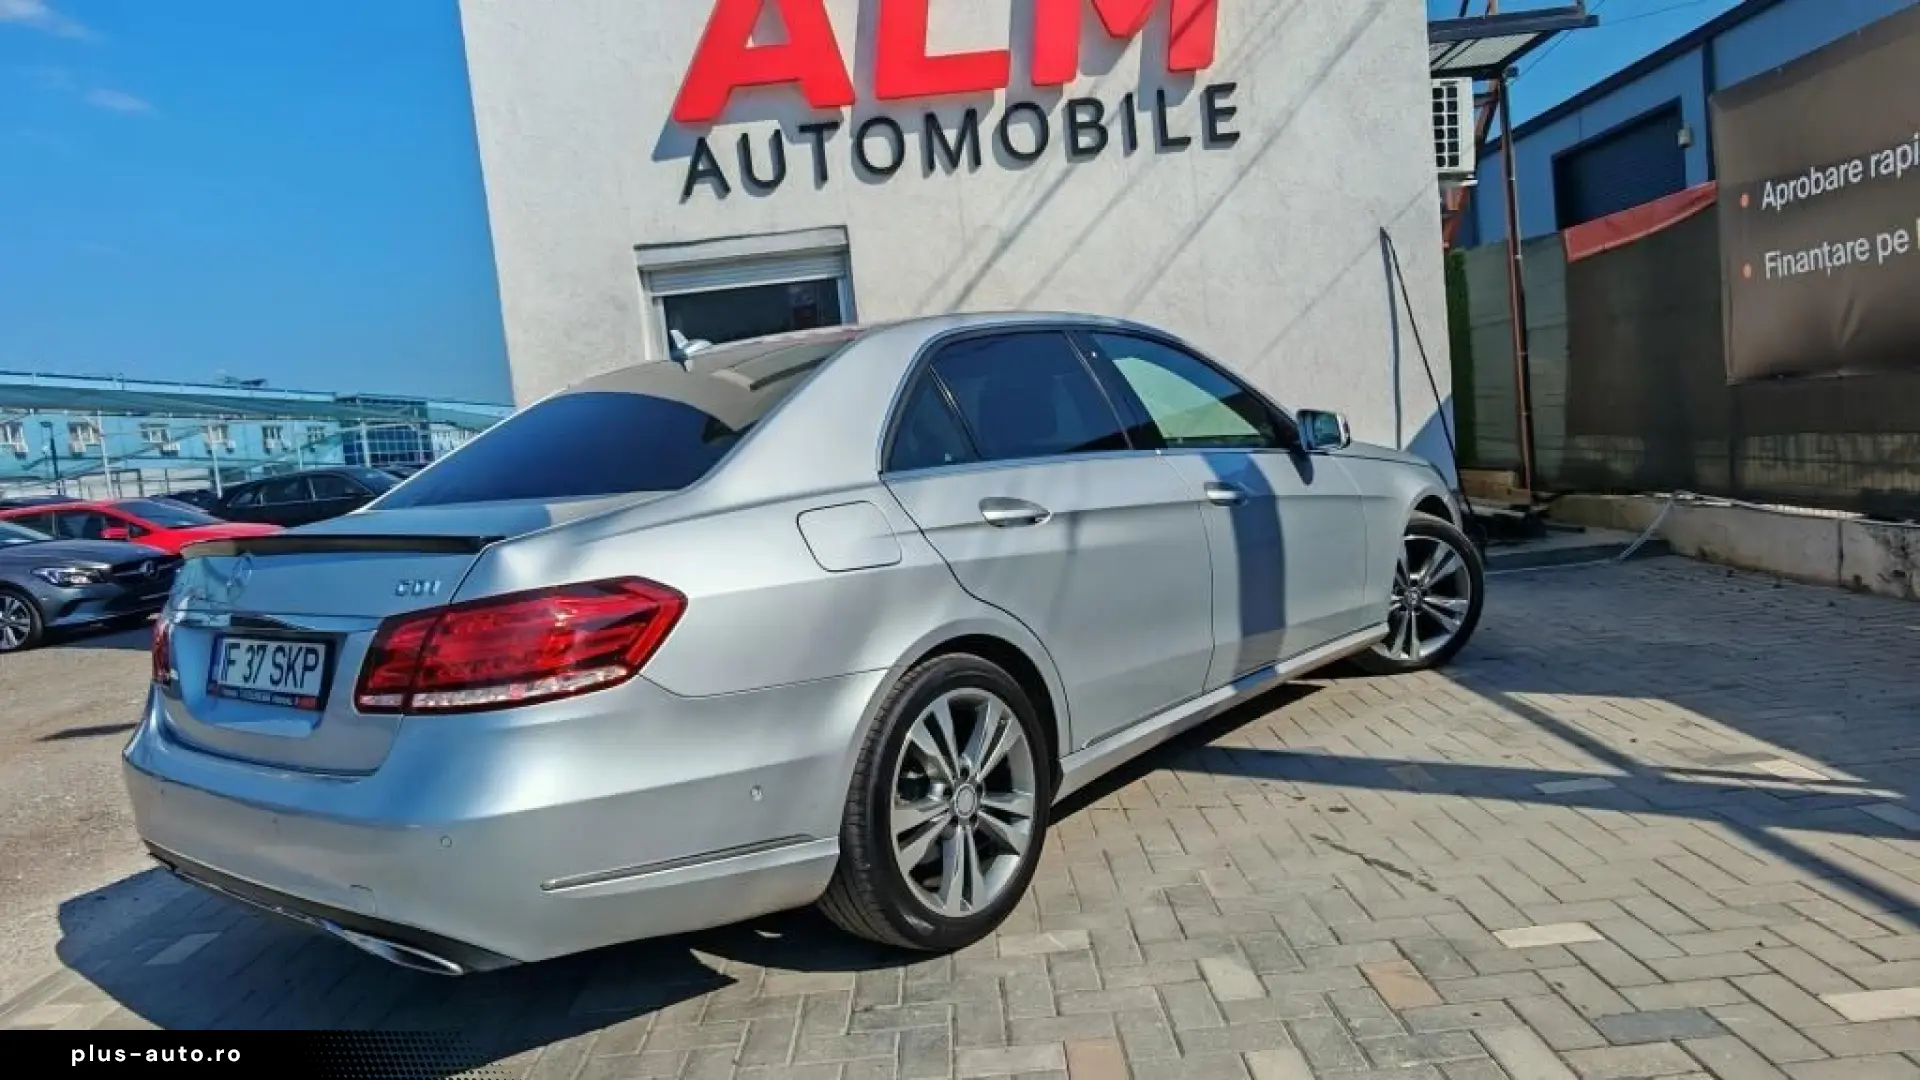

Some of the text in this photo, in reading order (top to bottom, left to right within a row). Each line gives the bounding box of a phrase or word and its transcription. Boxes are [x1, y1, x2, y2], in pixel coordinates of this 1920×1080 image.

[674, 0, 1219, 123] ALM
[681, 82, 1240, 198] AUTOMOBILE
[1761, 158, 1863, 211] Aprobare
[1876, 228, 1910, 265] pe
[243, 644, 268, 684] 37
[270, 645, 319, 689] SKP
